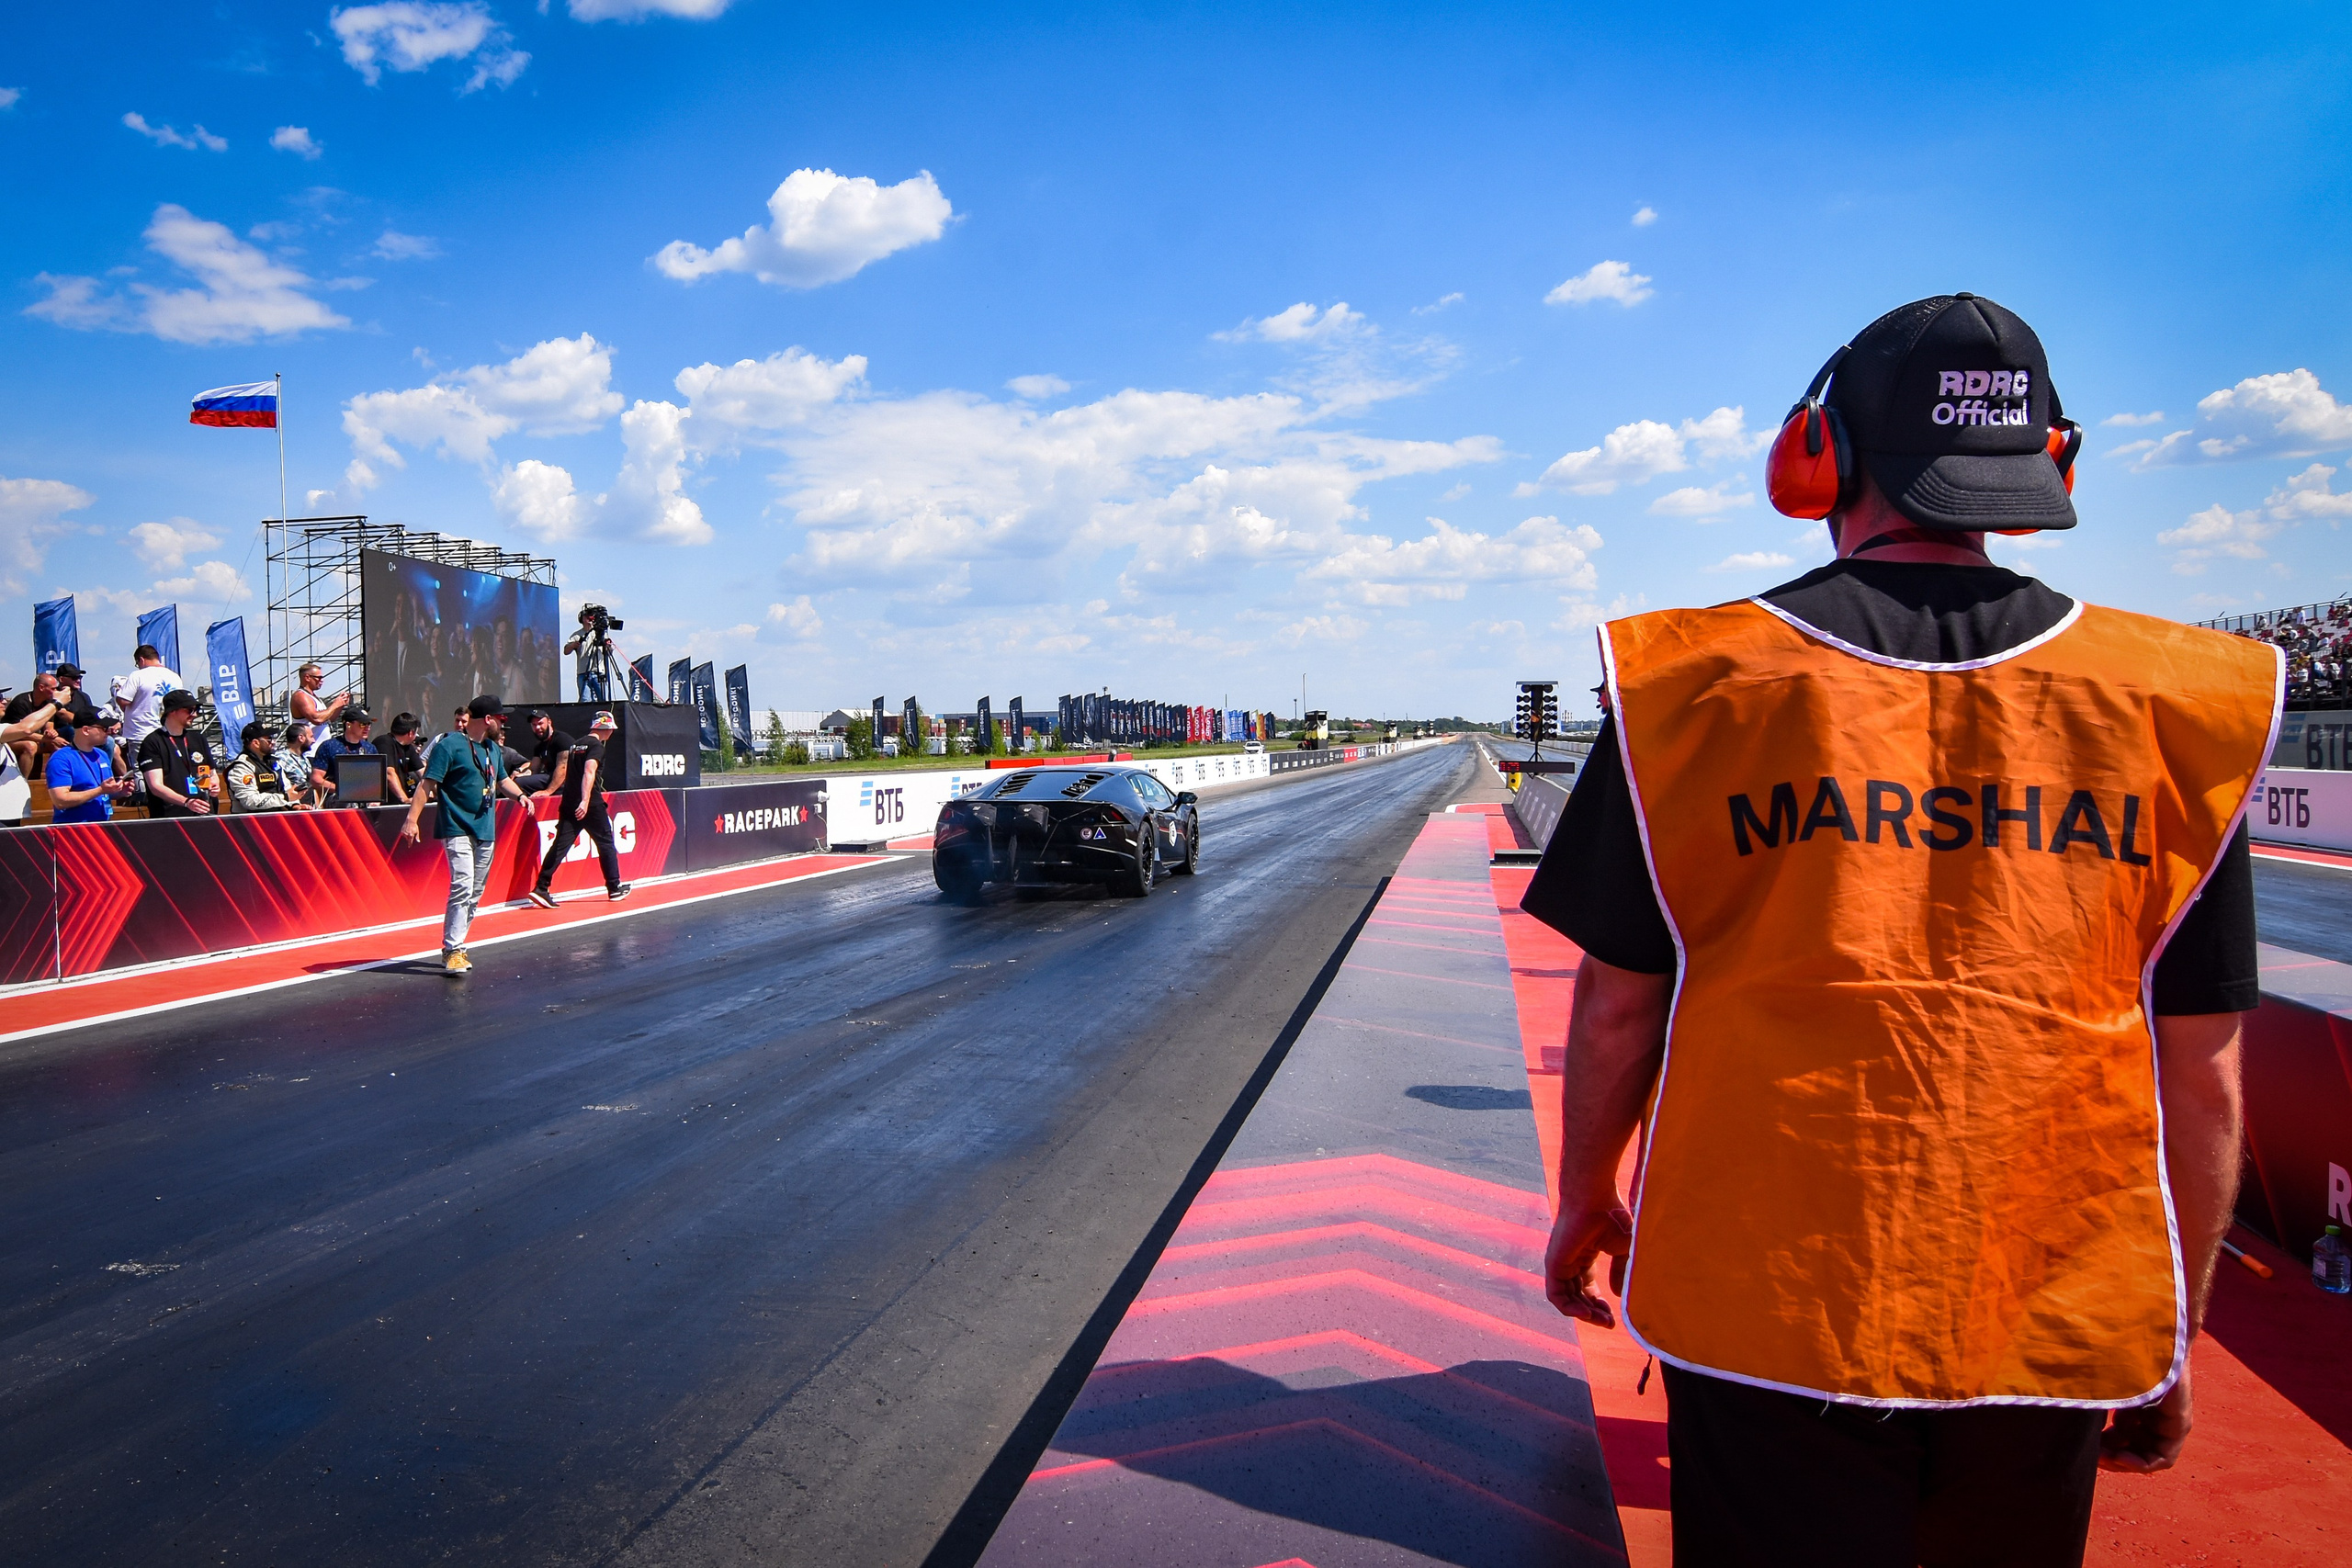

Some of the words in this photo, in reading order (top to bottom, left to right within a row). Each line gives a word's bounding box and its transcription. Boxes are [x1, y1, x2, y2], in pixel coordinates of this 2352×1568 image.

[1939, 370, 2029, 396] RDRC
[1932, 399, 2029, 425] Official
[641, 754, 685, 776] RDRC
[724, 806, 800, 834] RACEPARK
[876, 787, 904, 825] ВТБ
[2268, 786, 2311, 829] ВТБ
[1727, 776, 2152, 867] MARSHAL
